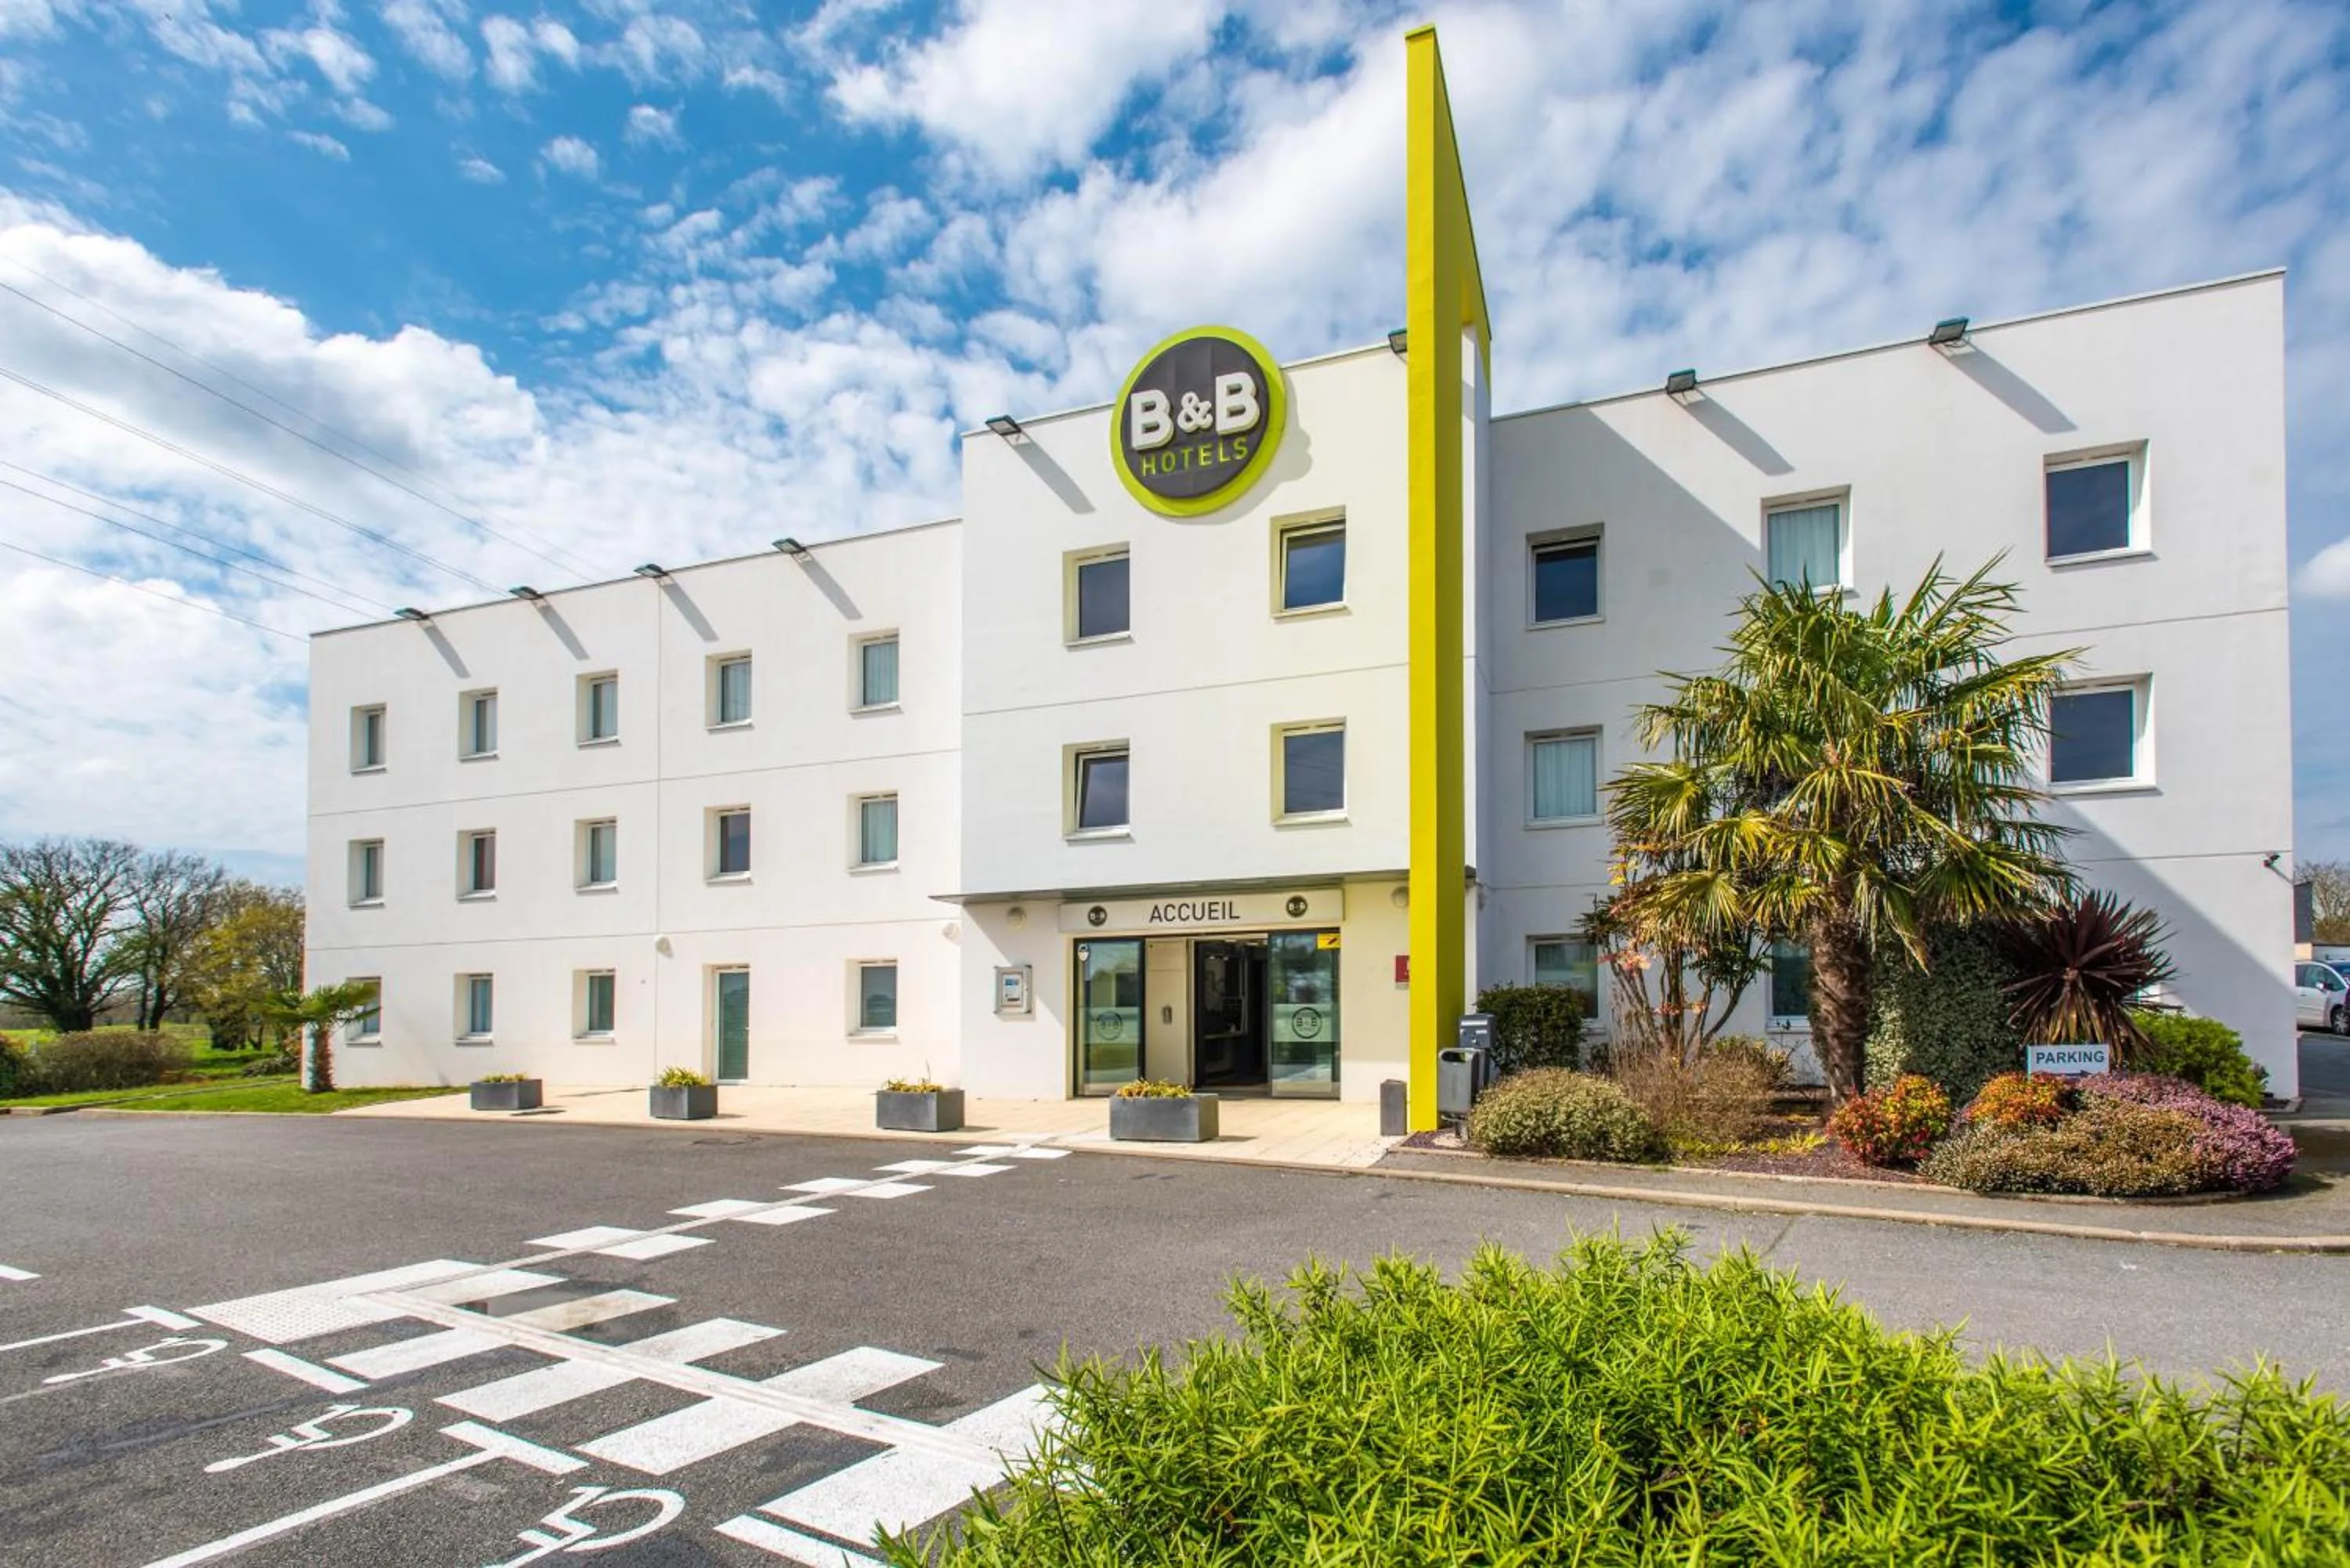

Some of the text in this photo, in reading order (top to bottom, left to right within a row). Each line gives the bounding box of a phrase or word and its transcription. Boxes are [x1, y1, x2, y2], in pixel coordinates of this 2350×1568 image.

[1131, 372, 1260, 450] B&B
[1141, 438, 1249, 476] HOTELS
[1149, 901, 1241, 923] ACCUEIL
[2037, 1050, 2105, 1064] PARKING
